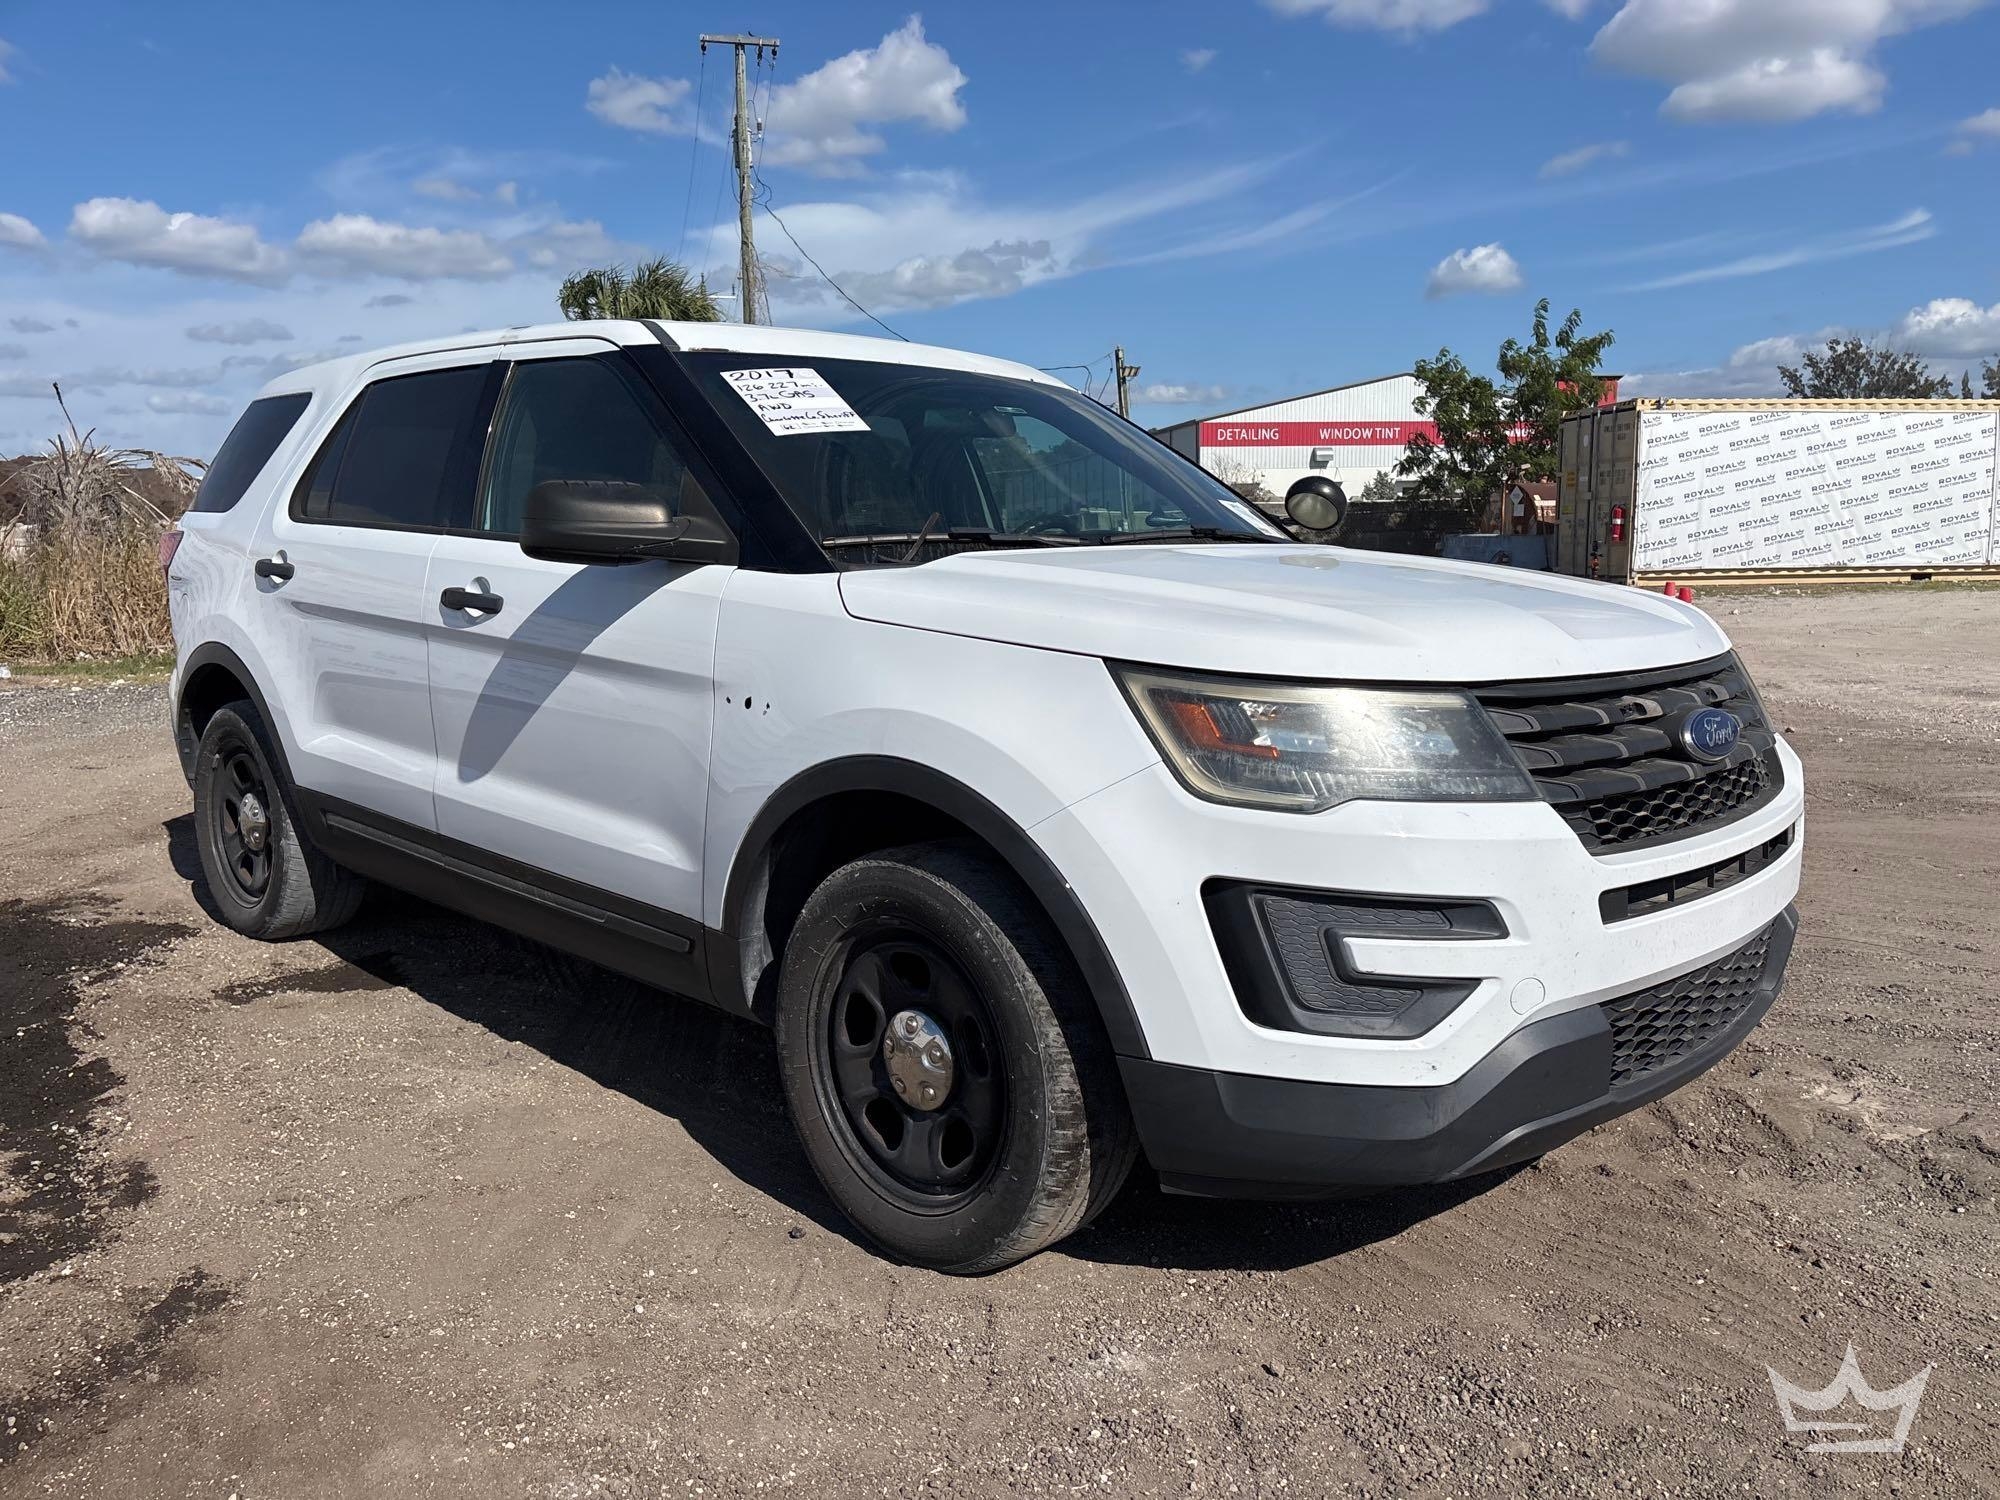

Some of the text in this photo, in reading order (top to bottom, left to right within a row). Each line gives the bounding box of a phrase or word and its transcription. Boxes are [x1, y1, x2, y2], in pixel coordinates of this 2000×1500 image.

[730, 370, 794, 381] 2017
[779, 390, 815, 398] GAS
[758, 403, 792, 411] AWD
[1750, 412, 1780, 422] ROYAL
[1830, 416, 1860, 426] ROYAL
[1699, 423, 1730, 433] ROYAL
[1906, 421, 1935, 431] ROYAL
[1218, 428, 1279, 441] DETAILING
[1319, 428, 1400, 440] WINDOW TINT
[1780, 426, 1810, 437] ROYAL
[1857, 431, 1887, 441] ROYAL
[1648, 434, 1679, 444] ROYAL
[1729, 437, 1760, 447] ROYAL
[1934, 435, 1963, 445] ROYAL
[1806, 441, 1837, 452] ROYAL
[1886, 445, 1916, 455] ROYAL
[1678, 448, 1709, 458] ROYAL
[1756, 452, 1787, 462] ROYAL
[1959, 450, 1988, 460] ROYAL
[1836, 456, 1866, 466] ROYAL
[1911, 460, 1941, 470] ROYAL
[1705, 463, 1736, 473] ROYAL
[1786, 466, 1816, 477] ROYAL
[1654, 474, 1685, 484] ROYAL
[1861, 471, 1892, 481] ROYAL
[1938, 474, 1968, 484] ROYAL
[1735, 477, 1765, 488] ROYAL
[1811, 481, 1842, 492] ROYAL
[1684, 488, 1714, 499] ROYAL
[1889, 485, 1919, 495] ROYAL
[1963, 489, 1990, 499] ROYAL
[1761, 492, 1791, 503] ROYAL
[1840, 496, 1870, 506] ROYAL
[1710, 503, 1740, 514] ROYAL
[1913, 500, 1943, 510] ROYAL
[1790, 506, 1820, 517] ROYAL
[1864, 510, 1894, 520] ROYAL
[1659, 514, 1689, 525] ROYAL
[1739, 517, 1769, 528] ROYAL
[1940, 513, 1970, 524] ROYAL
[1815, 521, 1845, 531] ROYAL
[1891, 524, 1921, 534] ROYAL
[1687, 529, 1718, 539] ROYAL
[1764, 532, 1794, 542] ROYAL
[1964, 529, 1989, 538] ROYA
[1842, 535, 1872, 545] ROYAL
[1915, 538, 1945, 549] ROYAL
[1713, 543, 1743, 553] ROYAL
[1792, 546, 1822, 556] ROYAL
[1662, 554, 1692, 564] ROYAL
[1866, 549, 1896, 560] ROYAL
[1943, 552, 1973, 562] ROYAL
[1704, 717, 1734, 746] Ford
